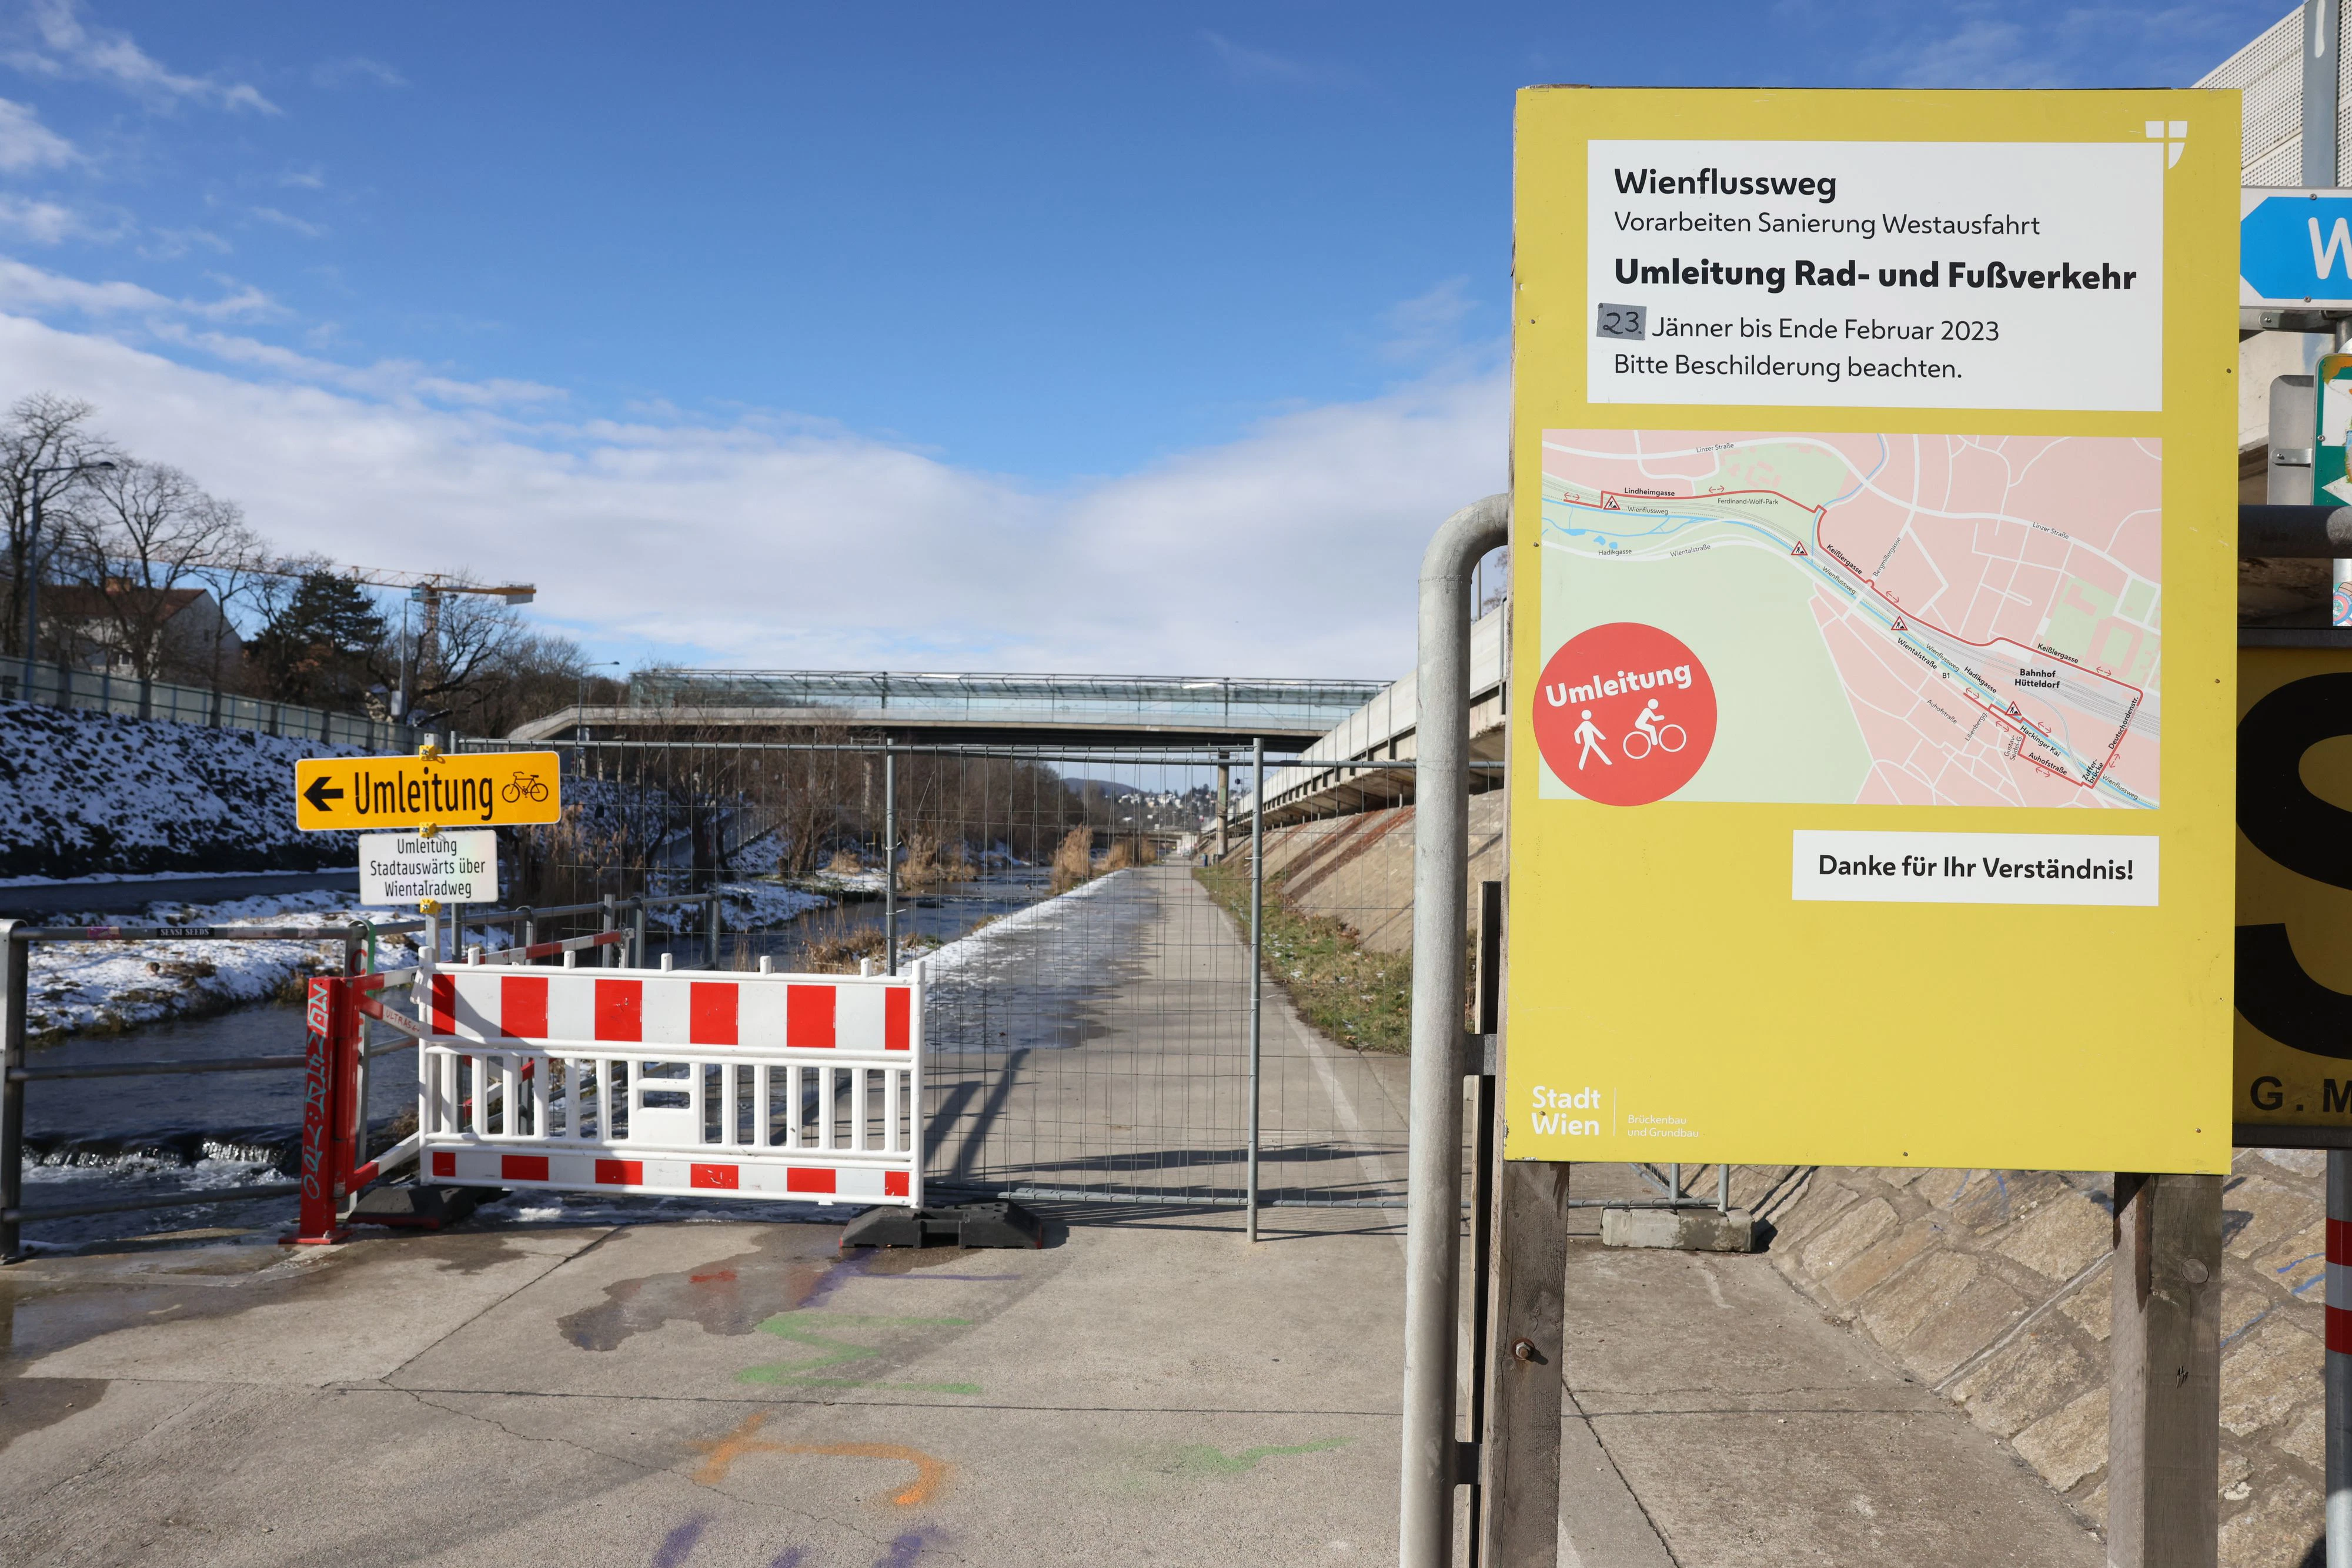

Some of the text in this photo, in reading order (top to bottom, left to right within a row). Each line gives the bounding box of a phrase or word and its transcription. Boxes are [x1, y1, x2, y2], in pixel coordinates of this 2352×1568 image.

[1614, 168, 1836, 204] Wienflussweg
[1614, 211, 2040, 239] Vorarbeiten Sanierung Westausfahrt
[1615, 258, 2137, 294] Umleitung Rad- und Fußverkehr
[1603, 312, 1999, 341] 23. Jänner bis Ende Februar 2023
[1615, 354, 1962, 383] Bitte Beschilderung beachten.
[1715, 443, 1734, 451] Straße
[1625, 487, 1675, 497] Lindheimgasse
[1628, 506, 1669, 516] Wienflussweg
[2032, 521, 2069, 539] Linzer Straße
[1670, 544, 1710, 557] Wientalstraße
[1826, 544, 1862, 574] Keißlergasse
[1873, 537, 1901, 577] Bergmillergasse
[1823, 566, 1856, 596] Wienflussweg
[1897, 637, 1937, 670] Wientalstraße
[1926, 643, 1960, 673] Wienflussweg
[2037, 643, 2079, 664] Keißlergasse
[1964, 666, 1997, 694] Hadikgasse
[2014, 678, 2060, 688] Hütteldorf
[2020, 668, 2056, 678] Bahnhof
[1545, 664, 1693, 707] Umleitung
[1927, 700, 1957, 724] Auhofstraße
[2108, 697, 2139, 750] Deutschordenstr.
[1965, 711, 1988, 742] Lilienbergg.
[2004, 735, 2014, 757] Gustav-
[2010, 735, 2023, 761] Seidel-G.
[2020, 725, 2061, 757] Hackinger Kai
[2029, 752, 2067, 775] Auhofstraße
[2082, 759, 2097, 781] Zuffer-
[2088, 762, 2103, 784] brücke
[355, 767, 493, 821] Umleitung
[2103, 774, 2139, 801] Wienflussweg
[397, 837, 457, 856] Umleitung
[370, 858, 486, 876] Stadtauswärts über
[1819, 854, 2133, 880] Danke für Ihr Verständnis!
[385, 880, 471, 898] Wientalradweg
[1532, 1085, 1601, 1109] Stadt
[1531, 1112, 1599, 1135] Wien
[1628, 1115, 1686, 1124] Brückenbau
[1628, 1128, 1699, 1138] und Grundbau
